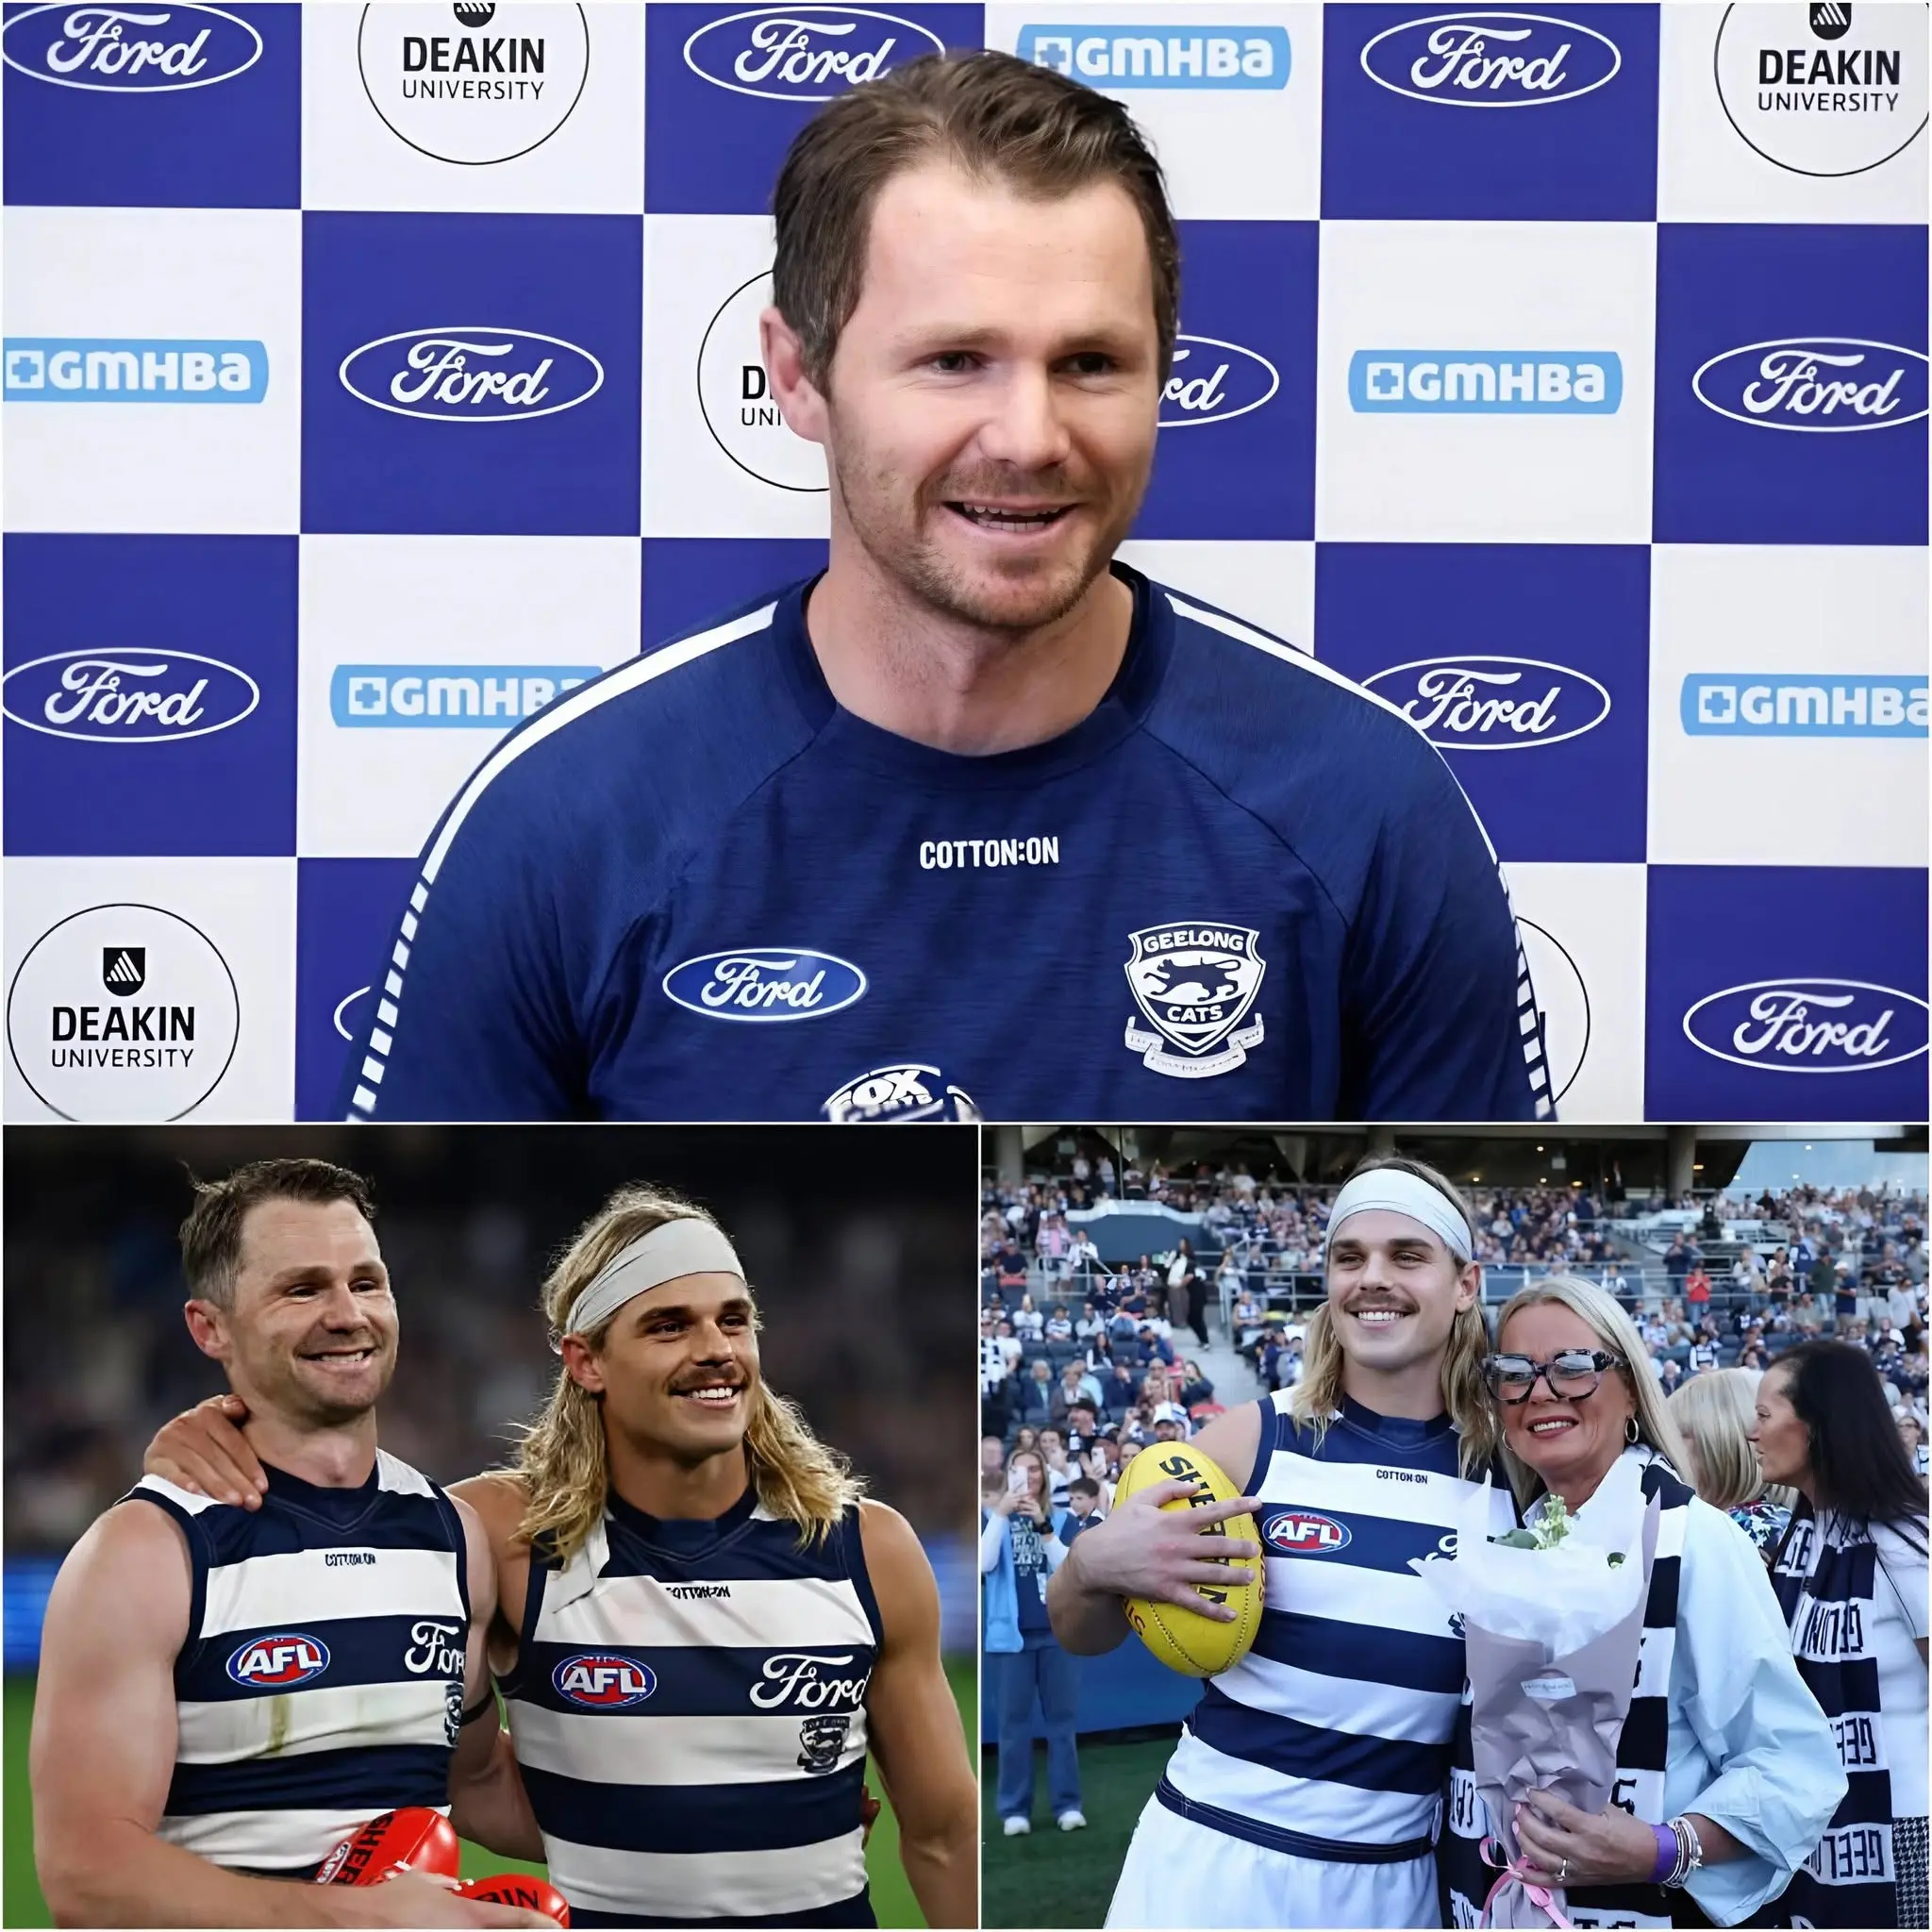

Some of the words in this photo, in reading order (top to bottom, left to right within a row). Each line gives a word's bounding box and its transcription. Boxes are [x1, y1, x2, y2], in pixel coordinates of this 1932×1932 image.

[47, 8, 211, 75] Ford
[404, 37, 544, 73] DEAKIN
[735, 19, 895, 84] Ford
[1411, 25, 1571, 90] Ford
[1759, 50, 1900, 85] DEAKIN
[404, 79, 544, 99] UNIVERSITY
[1758, 92, 1898, 111] UNIVERSITY
[391, 340, 553, 405] Ford
[1743, 350, 1904, 415] Ford
[45, 660, 208, 725] Ford
[1403, 669, 1561, 733] Ford
[1143, 930, 1244, 953] GEELONG
[702, 958, 825, 1007] Ford
[53, 1007, 194, 1041] DEAKIN
[1167, 1005, 1223, 1022] CATS
[1734, 991, 1893, 1056] Ford
[52, 1049, 193, 1067] UNIVERSITY
[1268, 1520, 1341, 1545] AFL
[238, 1644, 323, 1677] AFL
[562, 1666, 646, 1693] AFL
[750, 1654, 872, 1708] Ford
